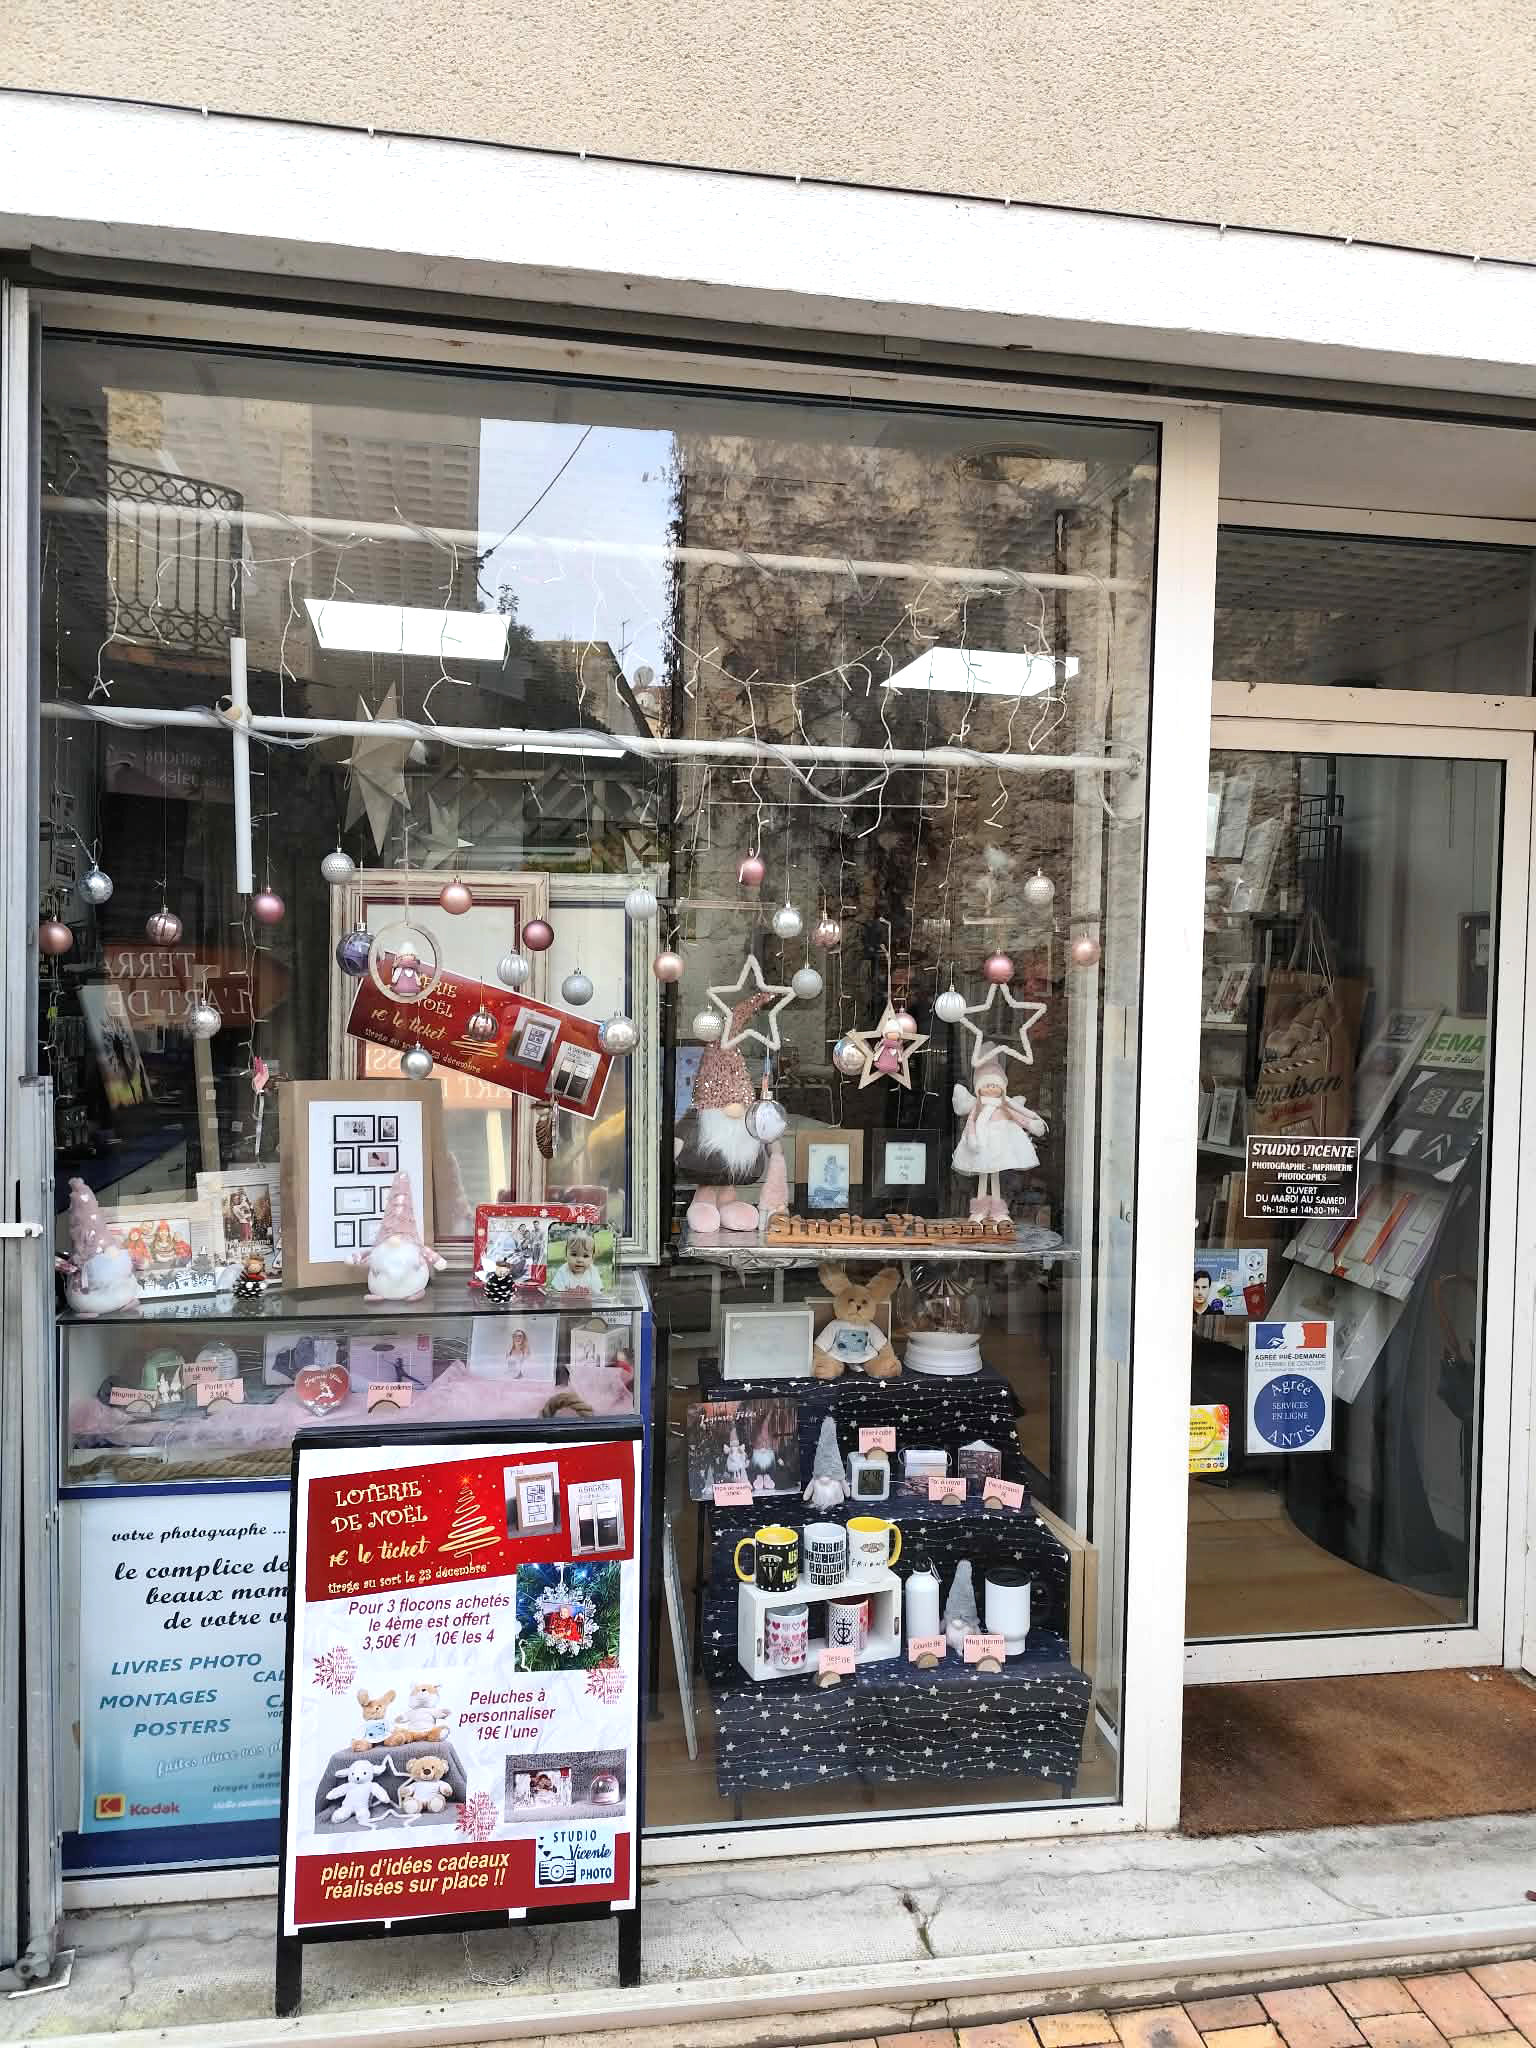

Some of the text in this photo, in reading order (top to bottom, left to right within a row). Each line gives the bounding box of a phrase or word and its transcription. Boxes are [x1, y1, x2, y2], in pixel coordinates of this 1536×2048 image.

[407, 1016, 448, 1041] ticket
[1252, 1143, 1356, 1158] STUDIO VICENTE
[1251, 1161, 1306, 1171] PHOTOGRAPHIE
[1312, 1163, 1353, 1172] IMPRIMERIE
[1277, 1172, 1327, 1181] PHOTOCOPIES
[1255, 1194, 1347, 1205] DU MARDI AU SAMEDI
[1285, 1186, 1318, 1195] OUVERT
[1262, 1205, 1340, 1215] 9h-12h et 14h30-19h
[1271, 1379, 1313, 1397] Agréé
[1272, 1401, 1309, 1410] SERVICES
[1272, 1411, 1309, 1420] EN LIGNE
[1267, 1424, 1316, 1446] ANTS
[335, 1480, 422, 1508] LOTERIE
[330, 1505, 428, 1533] DE NOËL
[112, 1530, 155, 1542] votre
[160, 1522, 268, 1543] photographe
[329, 1535, 431, 1568] 1€ le ticket
[114, 1561, 138, 1581] le
[145, 1556, 255, 1583] complice
[328, 1562, 487, 1594] tirage au sort le 23 décembre
[146, 1584, 288, 1605] beaux mom
[348, 1593, 511, 1616] Pour 3 flocons achetés
[163, 1609, 288, 1630] de votre vi
[369, 1612, 491, 1632] le 4ème est offert
[362, 1634, 402, 1651] 3,50€
[435, 1631, 459, 1647] 10€
[461, 1629, 482, 1645] les
[484, 1628, 495, 1644] 4
[111, 1652, 262, 1677] LIVRES PHOTO
[253, 1669, 286, 1684] CAL
[99, 1688, 218, 1710] MONTAGES
[469, 1687, 546, 1706] Peluches à
[458, 1706, 556, 1726] personnaliser
[133, 1717, 232, 1738] POSTERS
[476, 1722, 539, 1741] 19€ l'une
[130, 1800, 180, 1817] Kodak
[553, 1829, 598, 1843] STUDIO
[569, 1844, 613, 1860] Vicente
[320, 1851, 511, 1885] plein d'idées cadeaux
[580, 1866, 612, 1881] PHOTO
[324, 1867, 506, 1900] réalisées sur place !!
